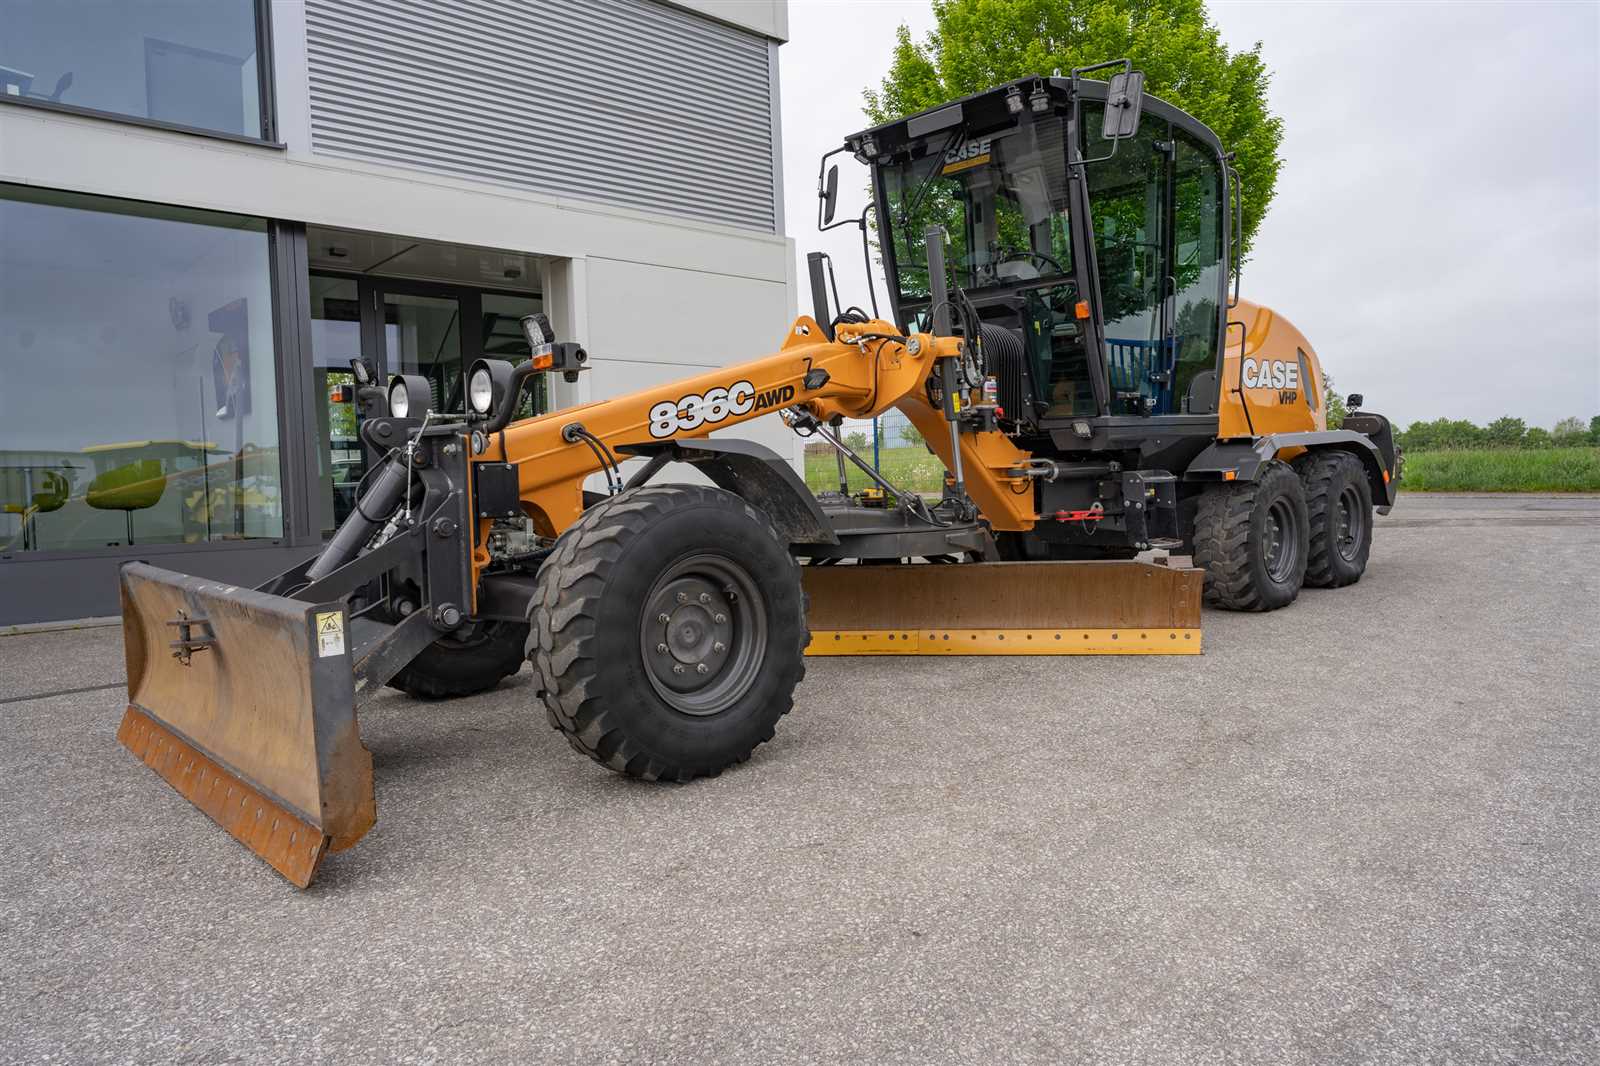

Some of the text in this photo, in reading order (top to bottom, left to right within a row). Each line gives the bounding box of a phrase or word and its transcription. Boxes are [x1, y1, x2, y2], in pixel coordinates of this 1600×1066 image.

[944, 139, 991, 163] CASE
[1242, 358, 1297, 390] CASE
[649, 380, 794, 439] 836C AWD
[1279, 391, 1297, 405] VHP
